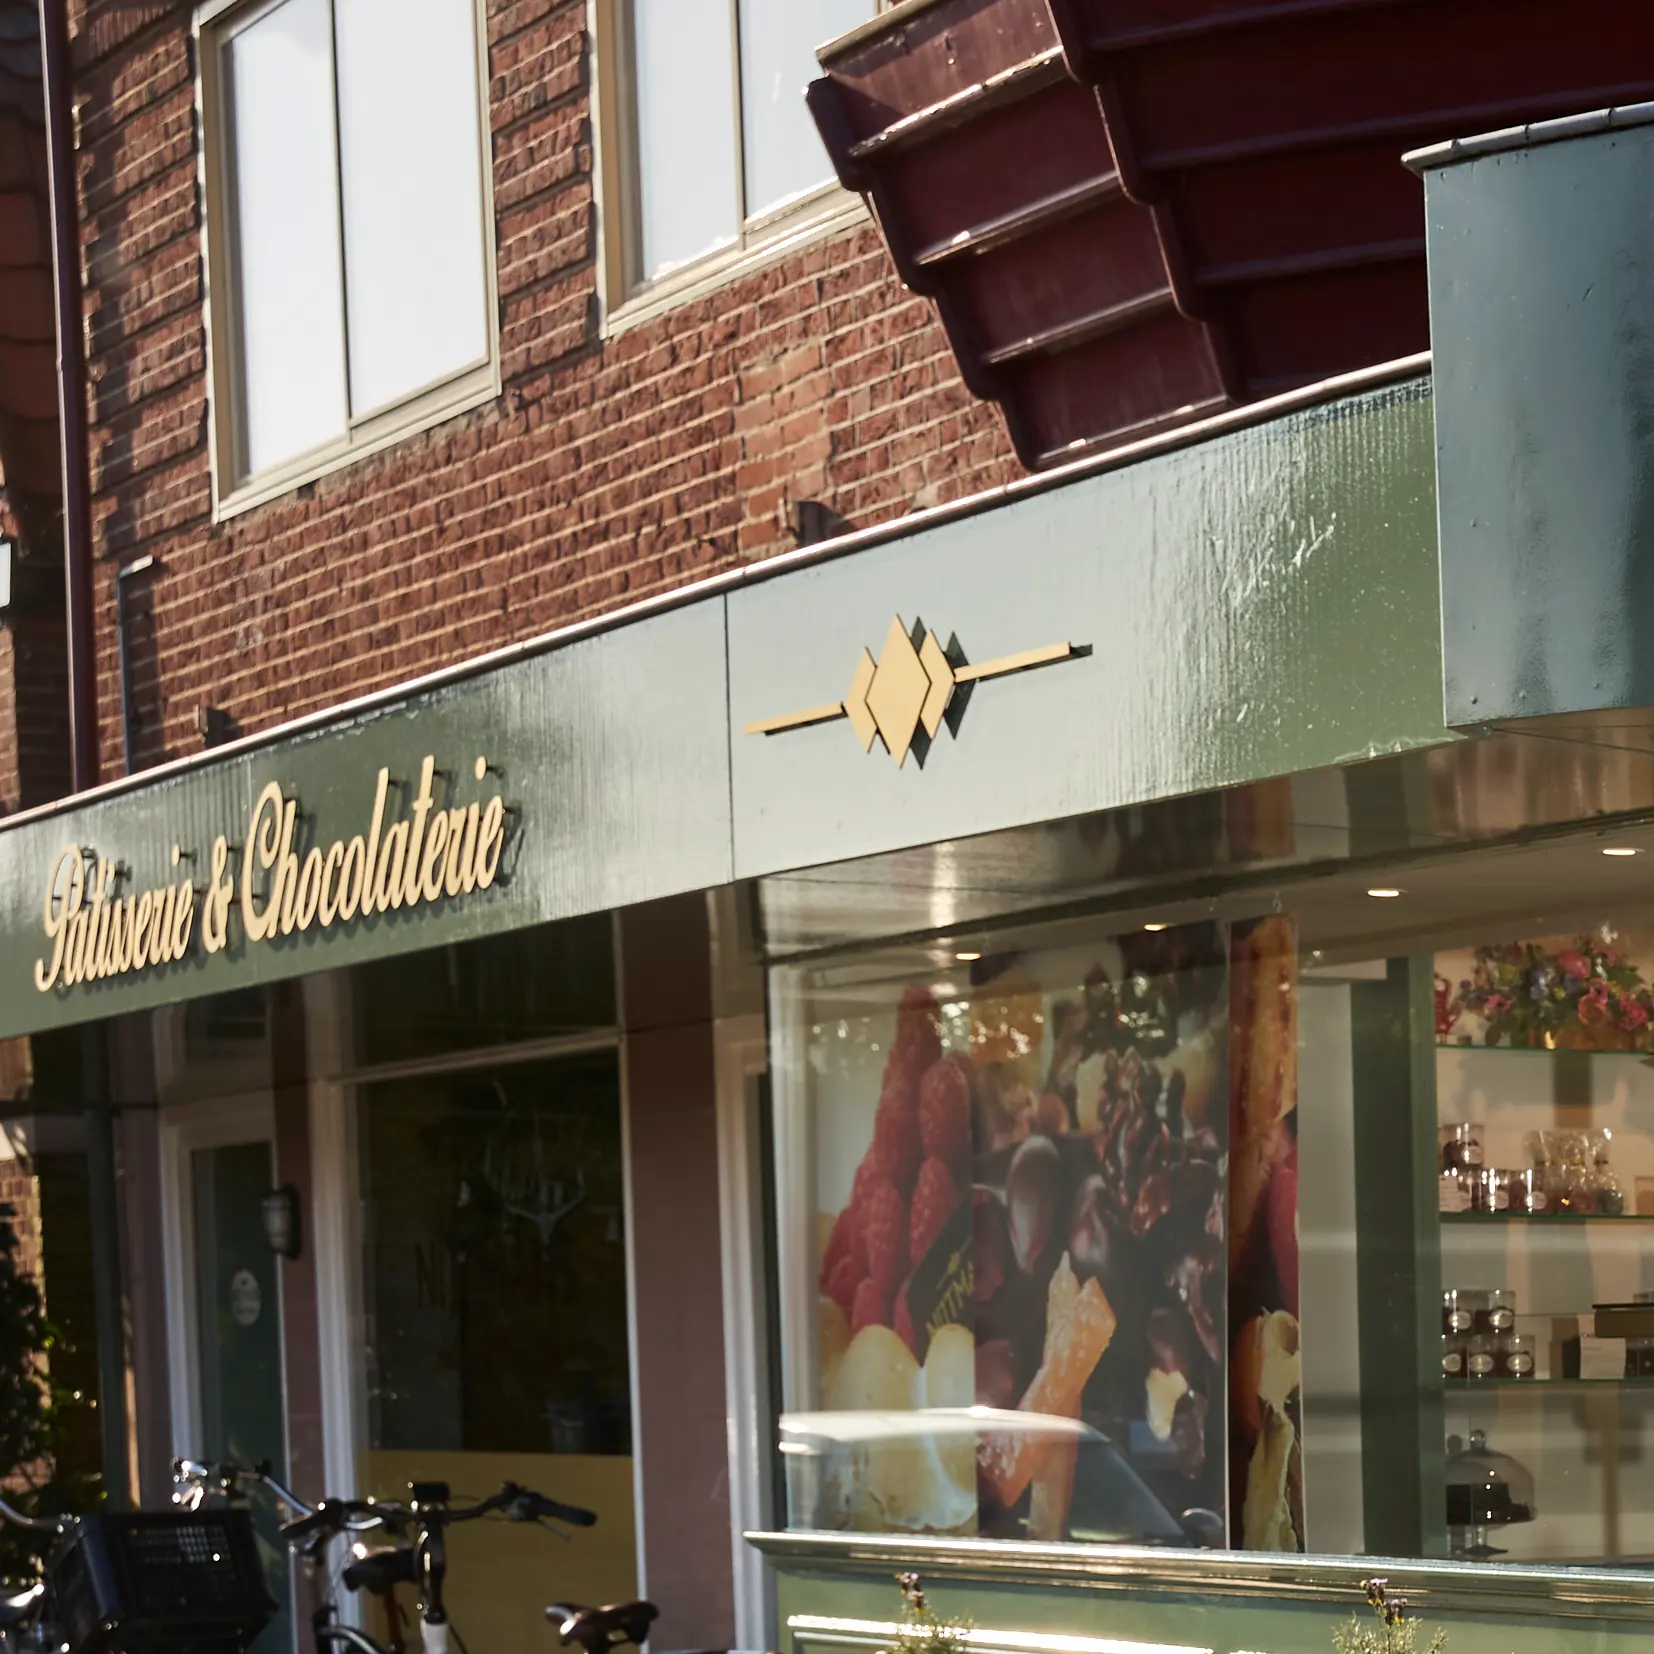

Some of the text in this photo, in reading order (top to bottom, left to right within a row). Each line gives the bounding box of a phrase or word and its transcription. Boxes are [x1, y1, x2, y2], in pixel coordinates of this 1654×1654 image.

[34, 753, 505, 992] Patisserie & Chocolaterie
